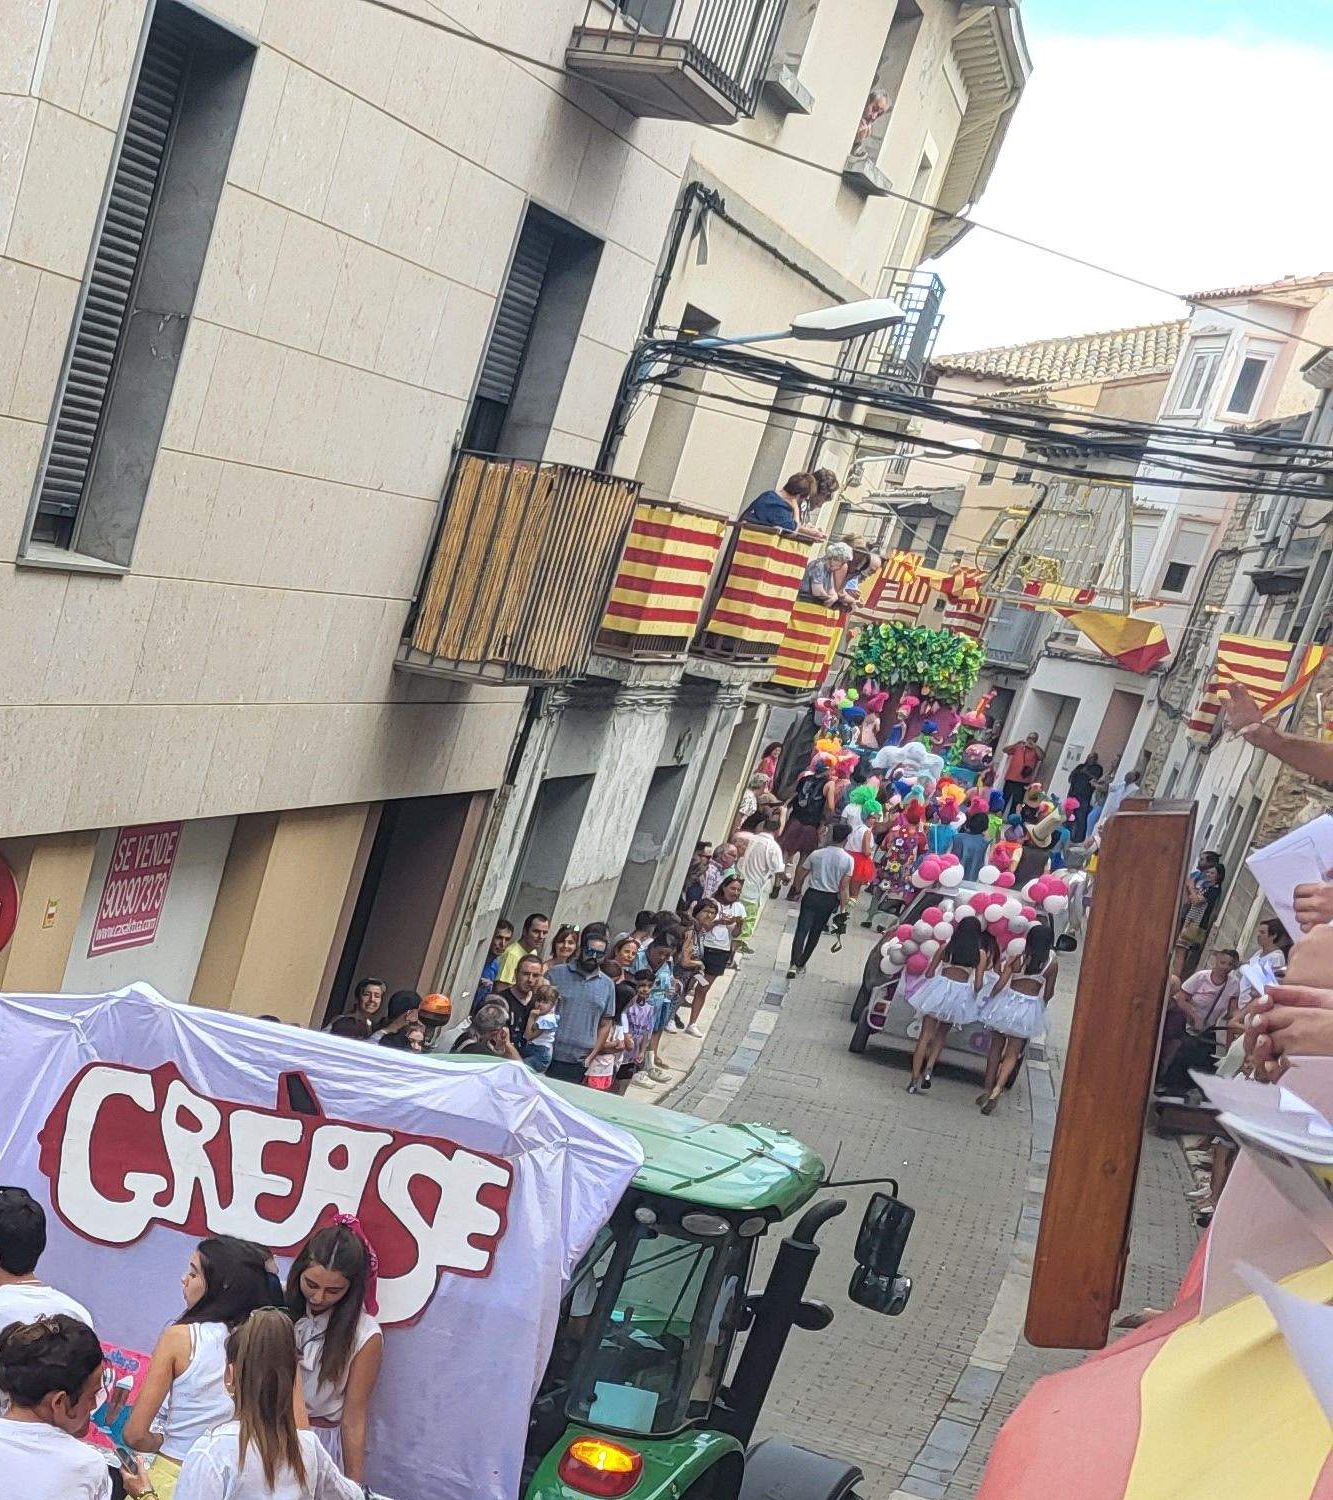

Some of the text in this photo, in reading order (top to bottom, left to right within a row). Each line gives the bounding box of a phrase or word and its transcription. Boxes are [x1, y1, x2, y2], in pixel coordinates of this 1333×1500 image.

[114, 831, 178, 873] SE VENDE
[57, 1066, 510, 1324] GREASE
